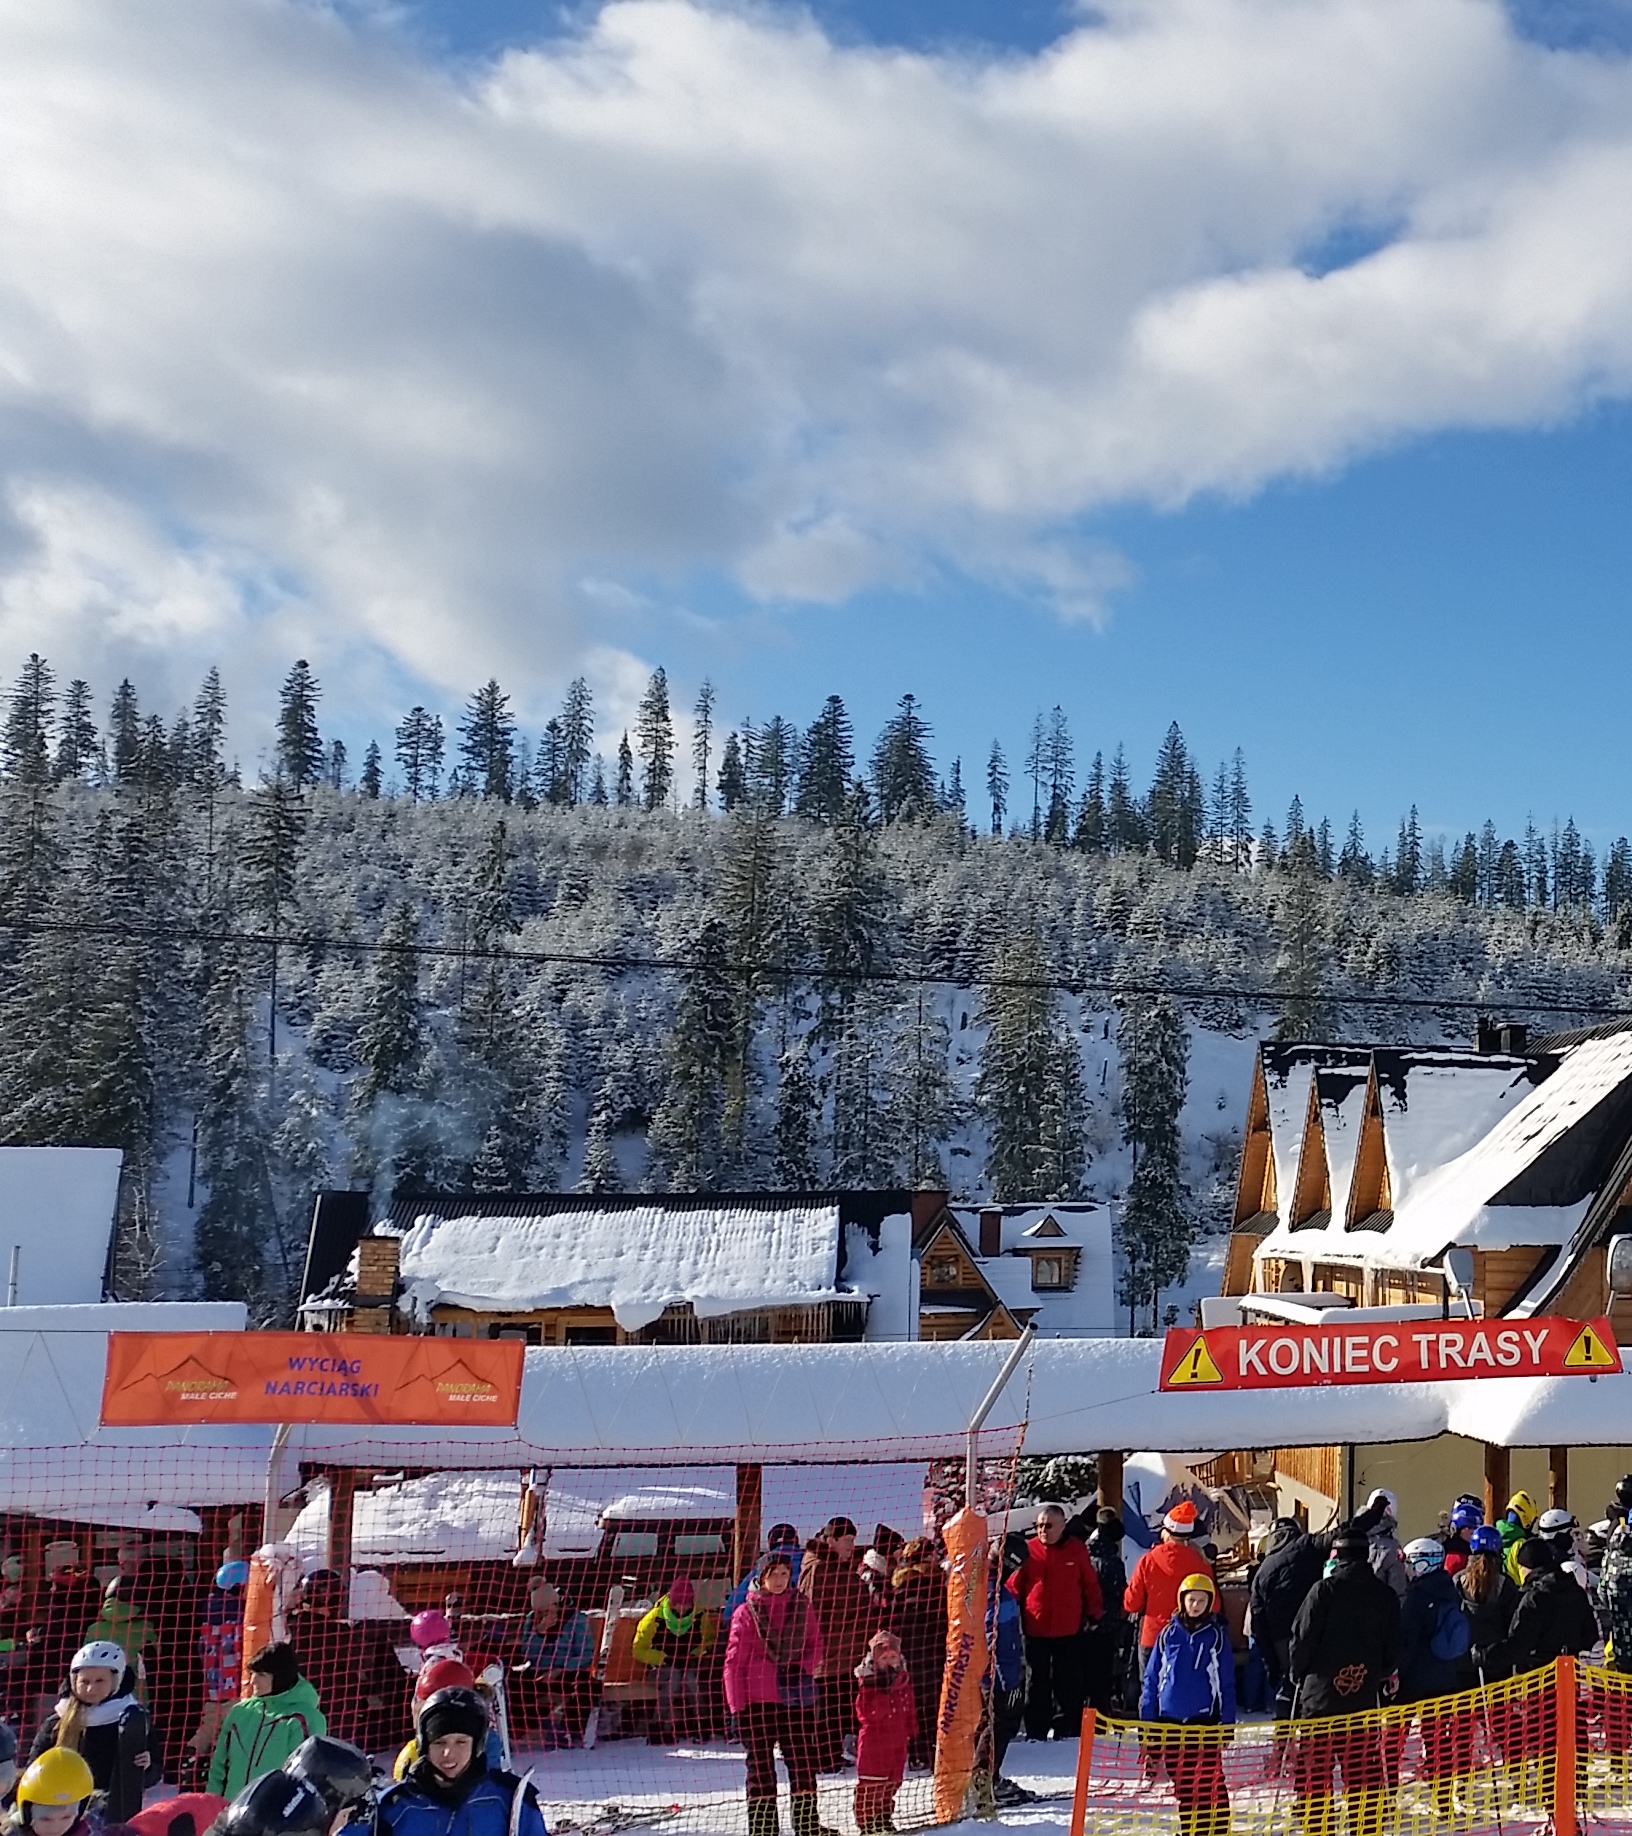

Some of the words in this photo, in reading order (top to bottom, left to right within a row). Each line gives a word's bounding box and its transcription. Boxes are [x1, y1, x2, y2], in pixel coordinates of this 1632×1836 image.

[1238, 1334, 1400, 1376] KONIEC
[1411, 1328, 1549, 1370] TRASY
[288, 1357, 362, 1376] WYCIĄG
[165, 1380, 229, 1392] PANORAMA
[264, 1381, 379, 1397] NARCIARSKI
[436, 1382, 492, 1394] PANORAMA
[209, 1391, 238, 1400] CICHE
